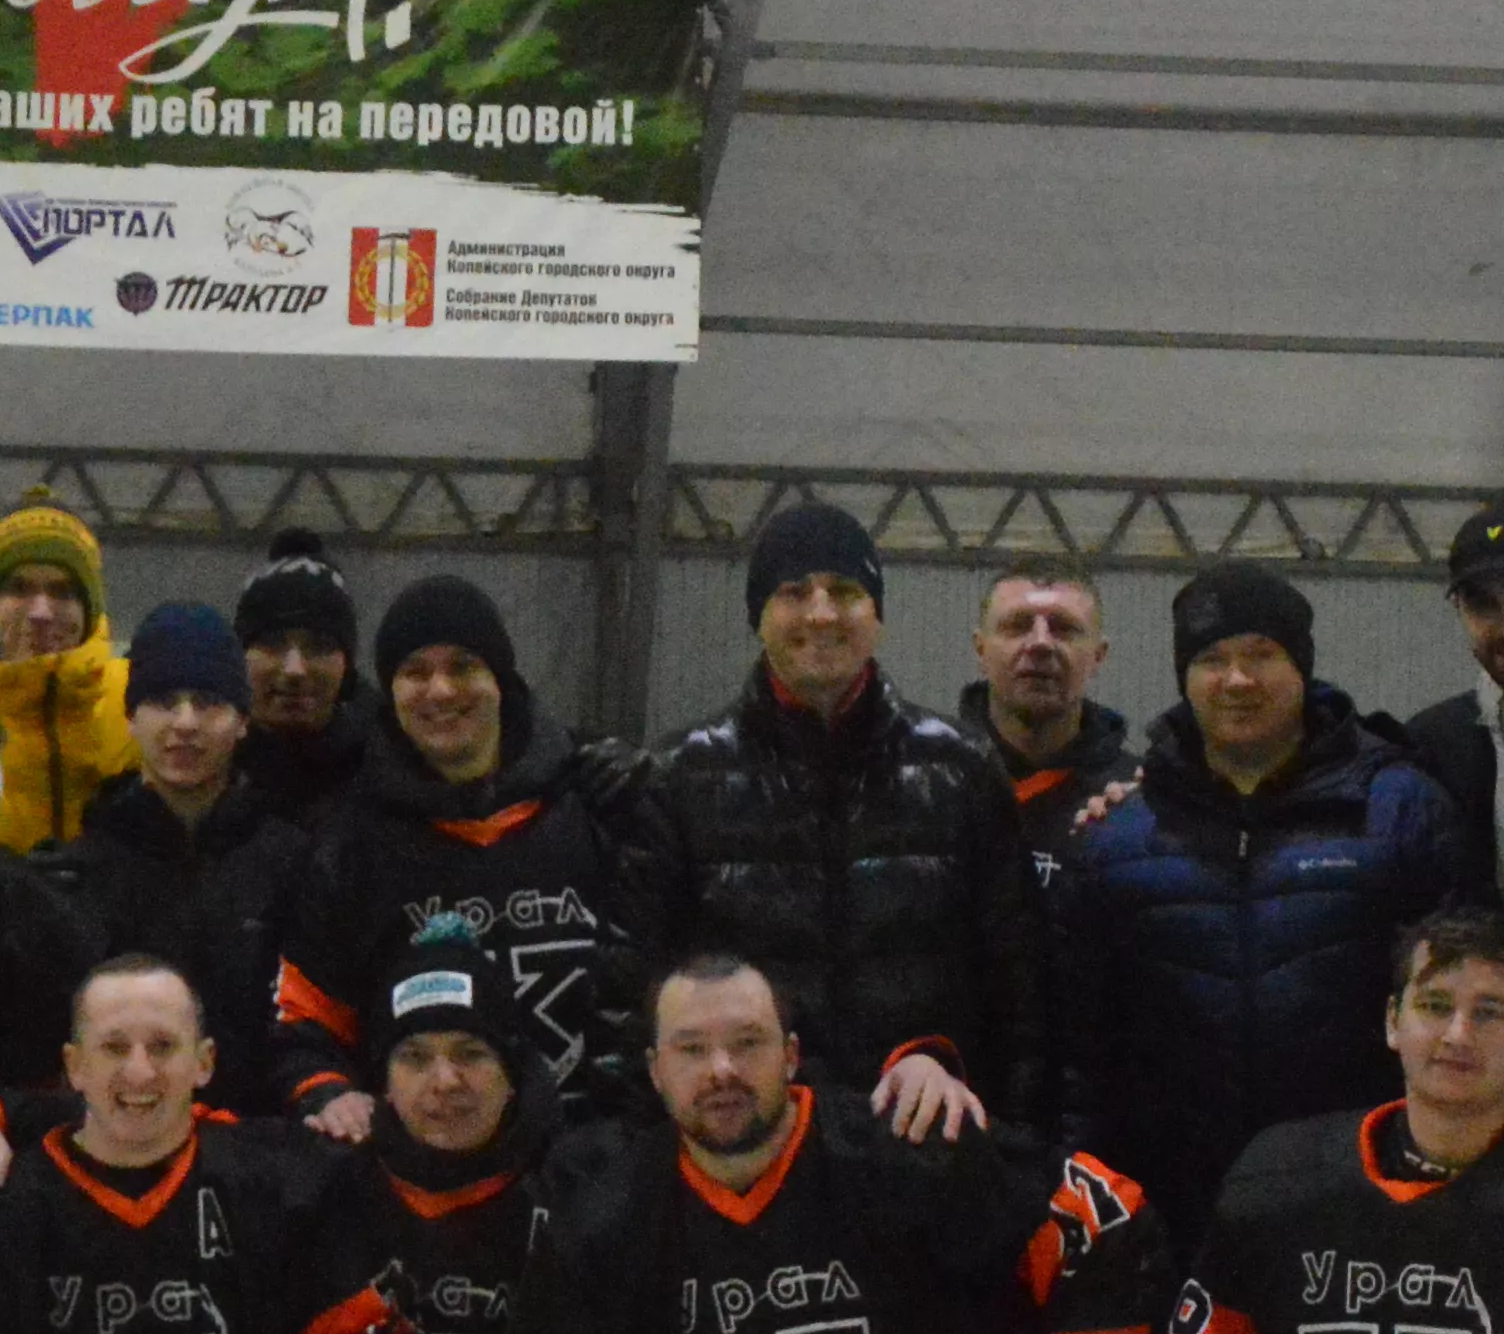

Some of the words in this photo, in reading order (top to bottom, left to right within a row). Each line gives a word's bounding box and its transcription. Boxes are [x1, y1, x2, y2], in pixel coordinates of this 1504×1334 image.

[130, 86, 274, 140] ребят
[287, 99, 343, 139] на
[358, 99, 635, 147] передовой!
[42, 207, 177, 239] ПОРТАЛ
[447, 240, 566, 258] Администрация
[447, 259, 533, 276] Копейского
[537, 262, 622, 279] городского
[625, 264, 676, 279] округа
[446, 288, 517, 307] Собрание
[445, 305, 532, 322] Копейского
[535, 307, 620, 325] городского
[624, 310, 675, 326] округа
[1301, 1249, 1478, 1314] Урал
